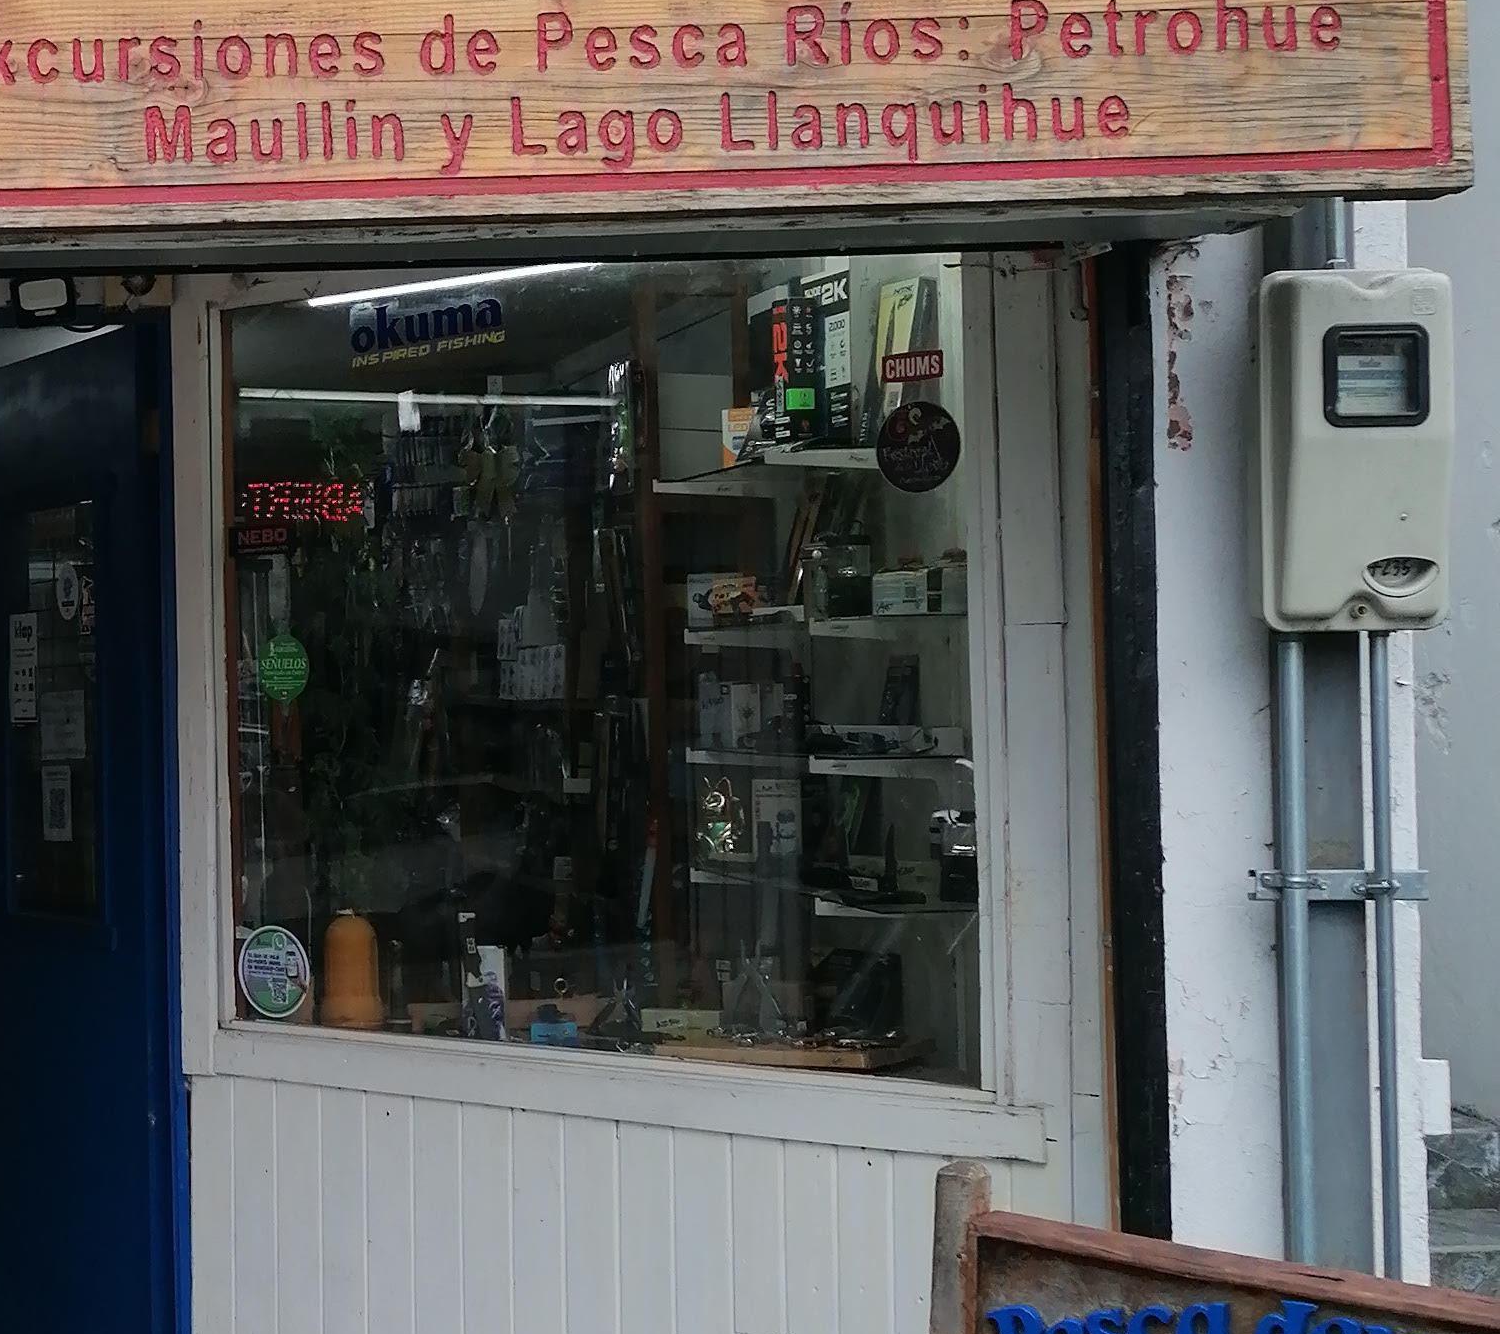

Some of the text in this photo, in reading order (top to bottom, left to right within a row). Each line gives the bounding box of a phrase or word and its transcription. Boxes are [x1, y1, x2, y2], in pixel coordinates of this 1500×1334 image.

[420, 12, 500, 76] de
[535, 10, 749, 72] Pesca
[438, 113, 474, 175] y
[510, 95, 684, 171] Lago
[719, 83, 1132, 163] Llanquihue
[351, 298, 503, 354] okuma
[351, 330, 506, 369] INSPIRED FISHING
[885, 353, 942, 380] CHUMS
